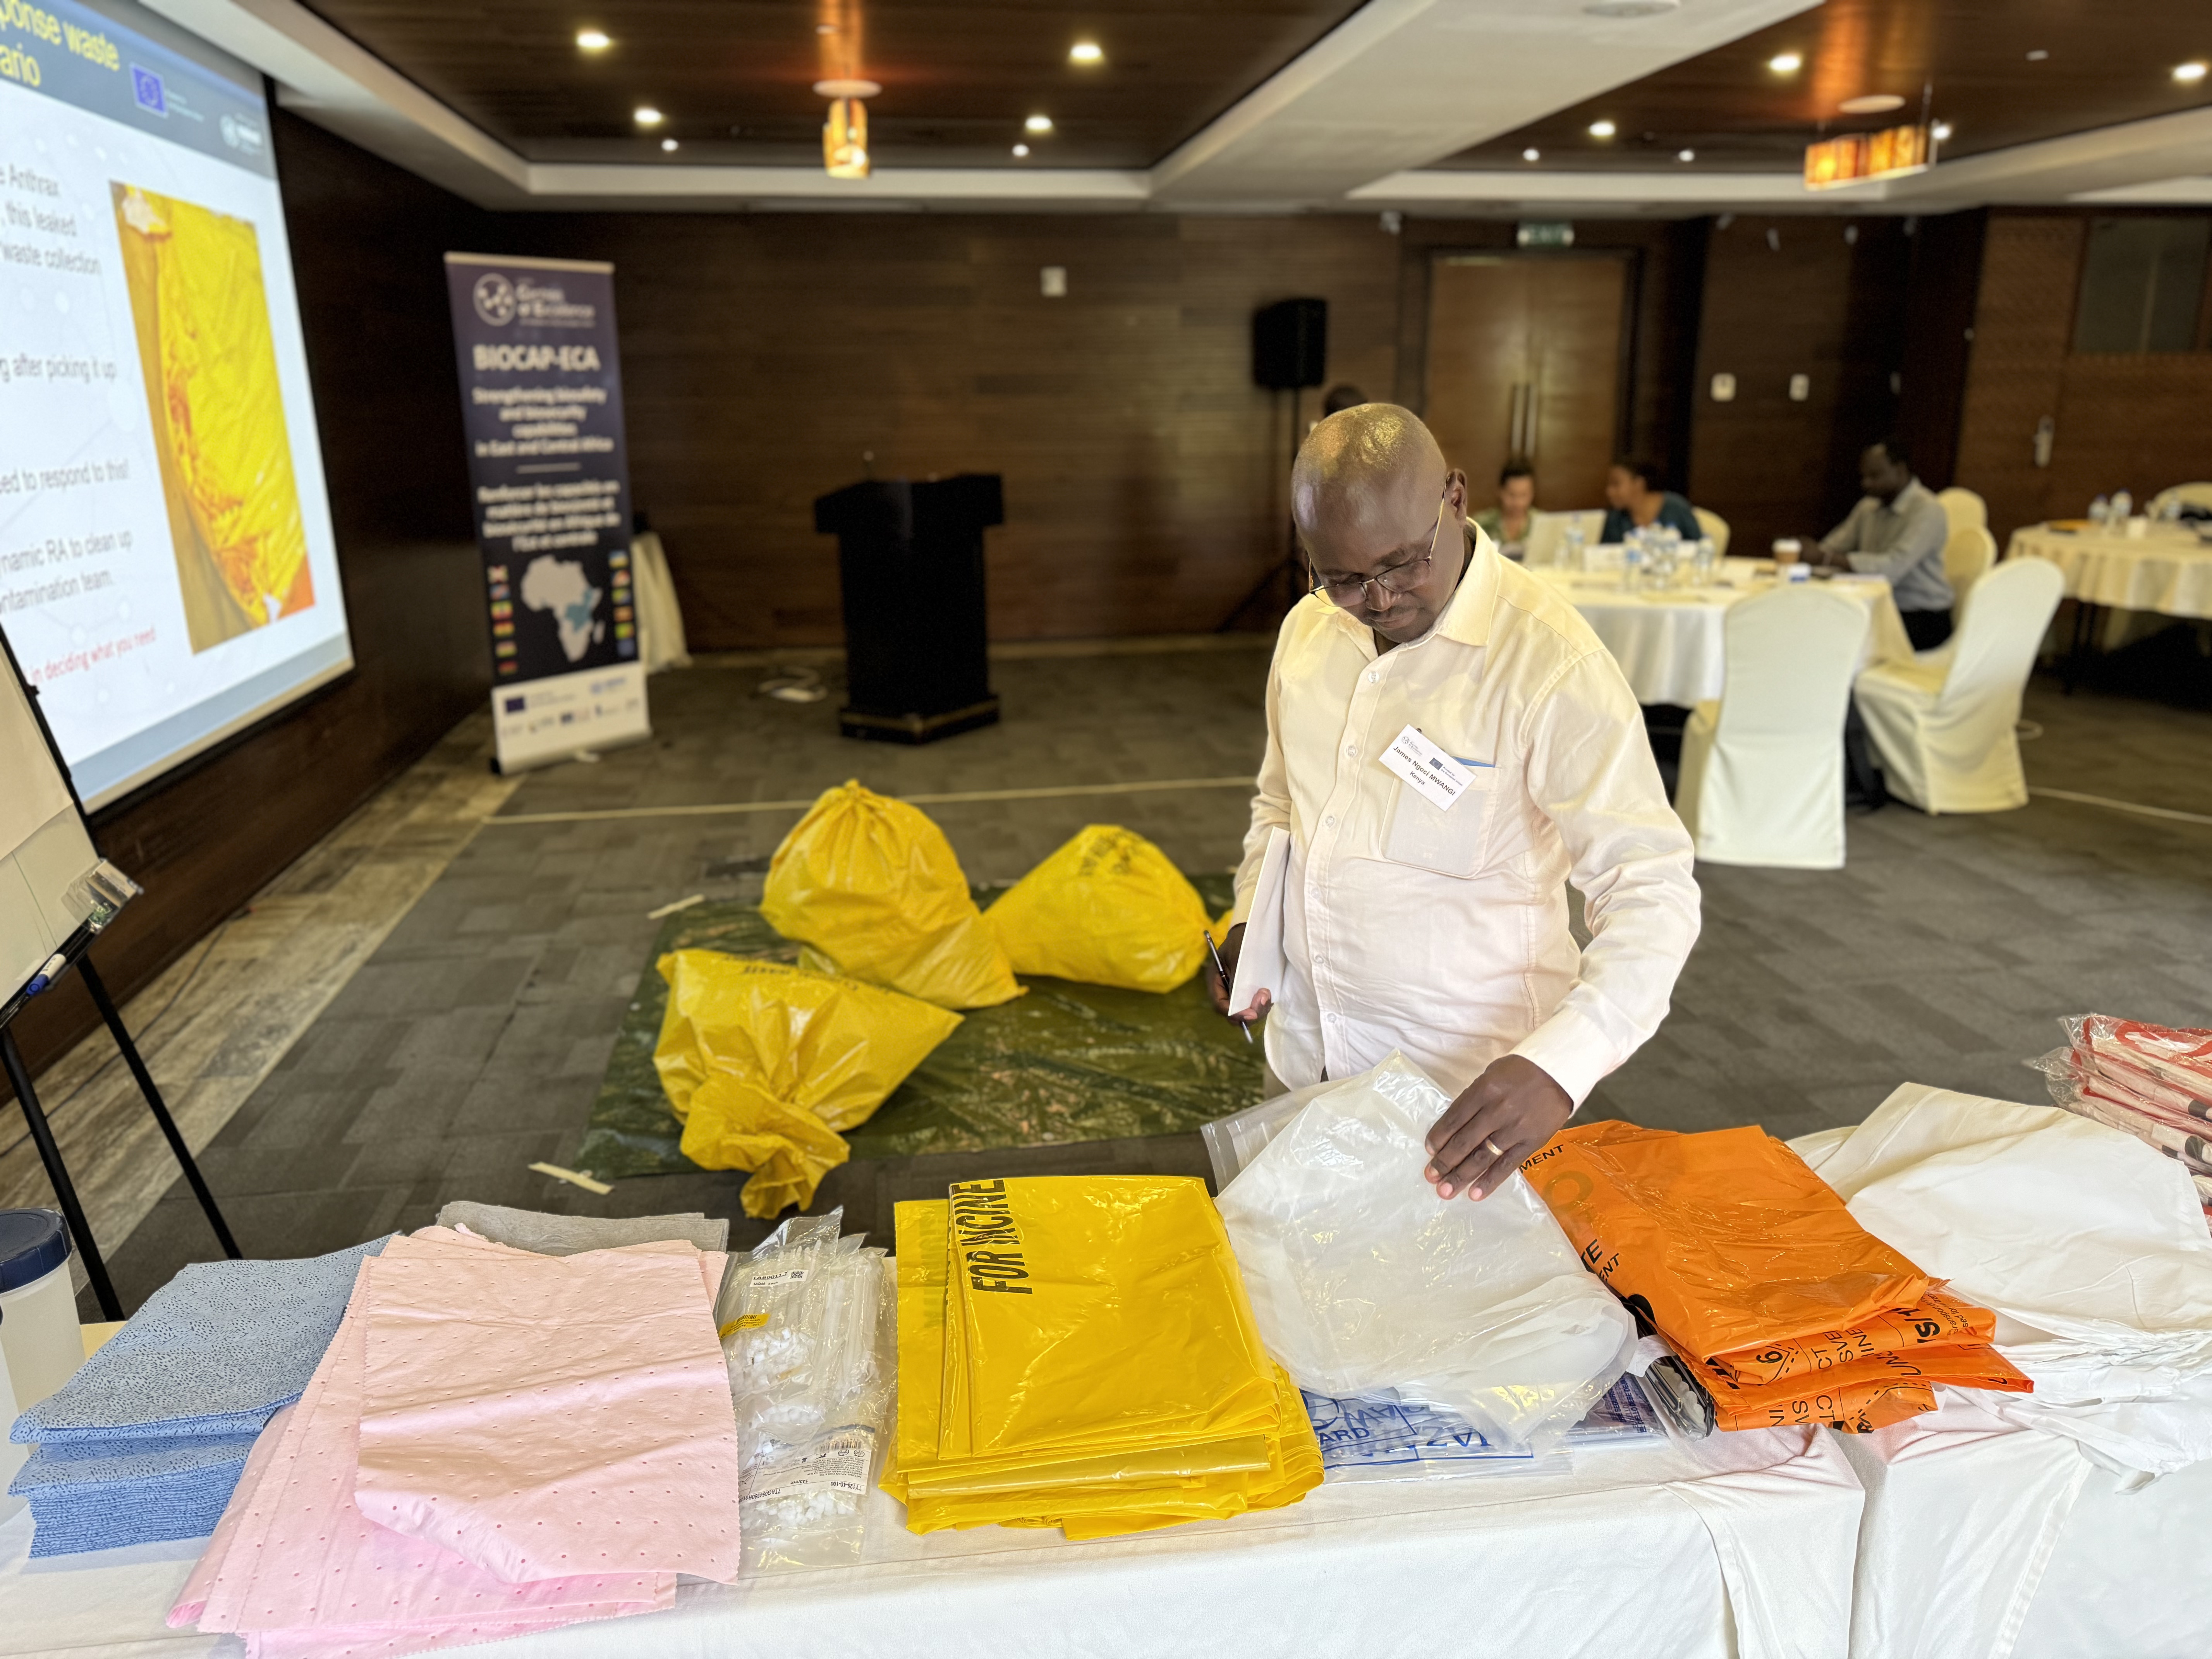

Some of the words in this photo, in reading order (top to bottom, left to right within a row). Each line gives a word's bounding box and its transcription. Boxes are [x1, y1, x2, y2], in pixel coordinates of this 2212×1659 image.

[62, 21, 120, 71] waste
[45, 247, 101, 276] collection
[46, 354, 90, 384] picking
[22, 467, 37, 491] to
[40, 461, 91, 494] respond
[84, 531, 115, 555] clean
[0, 575, 79, 615] ntamination
[1410, 771, 1425, 785] Kenya
[1429, 774, 1456, 796] MWANGI
[950, 1179, 1021, 1247] INCINE
[966, 1250, 1033, 1295] FOR
